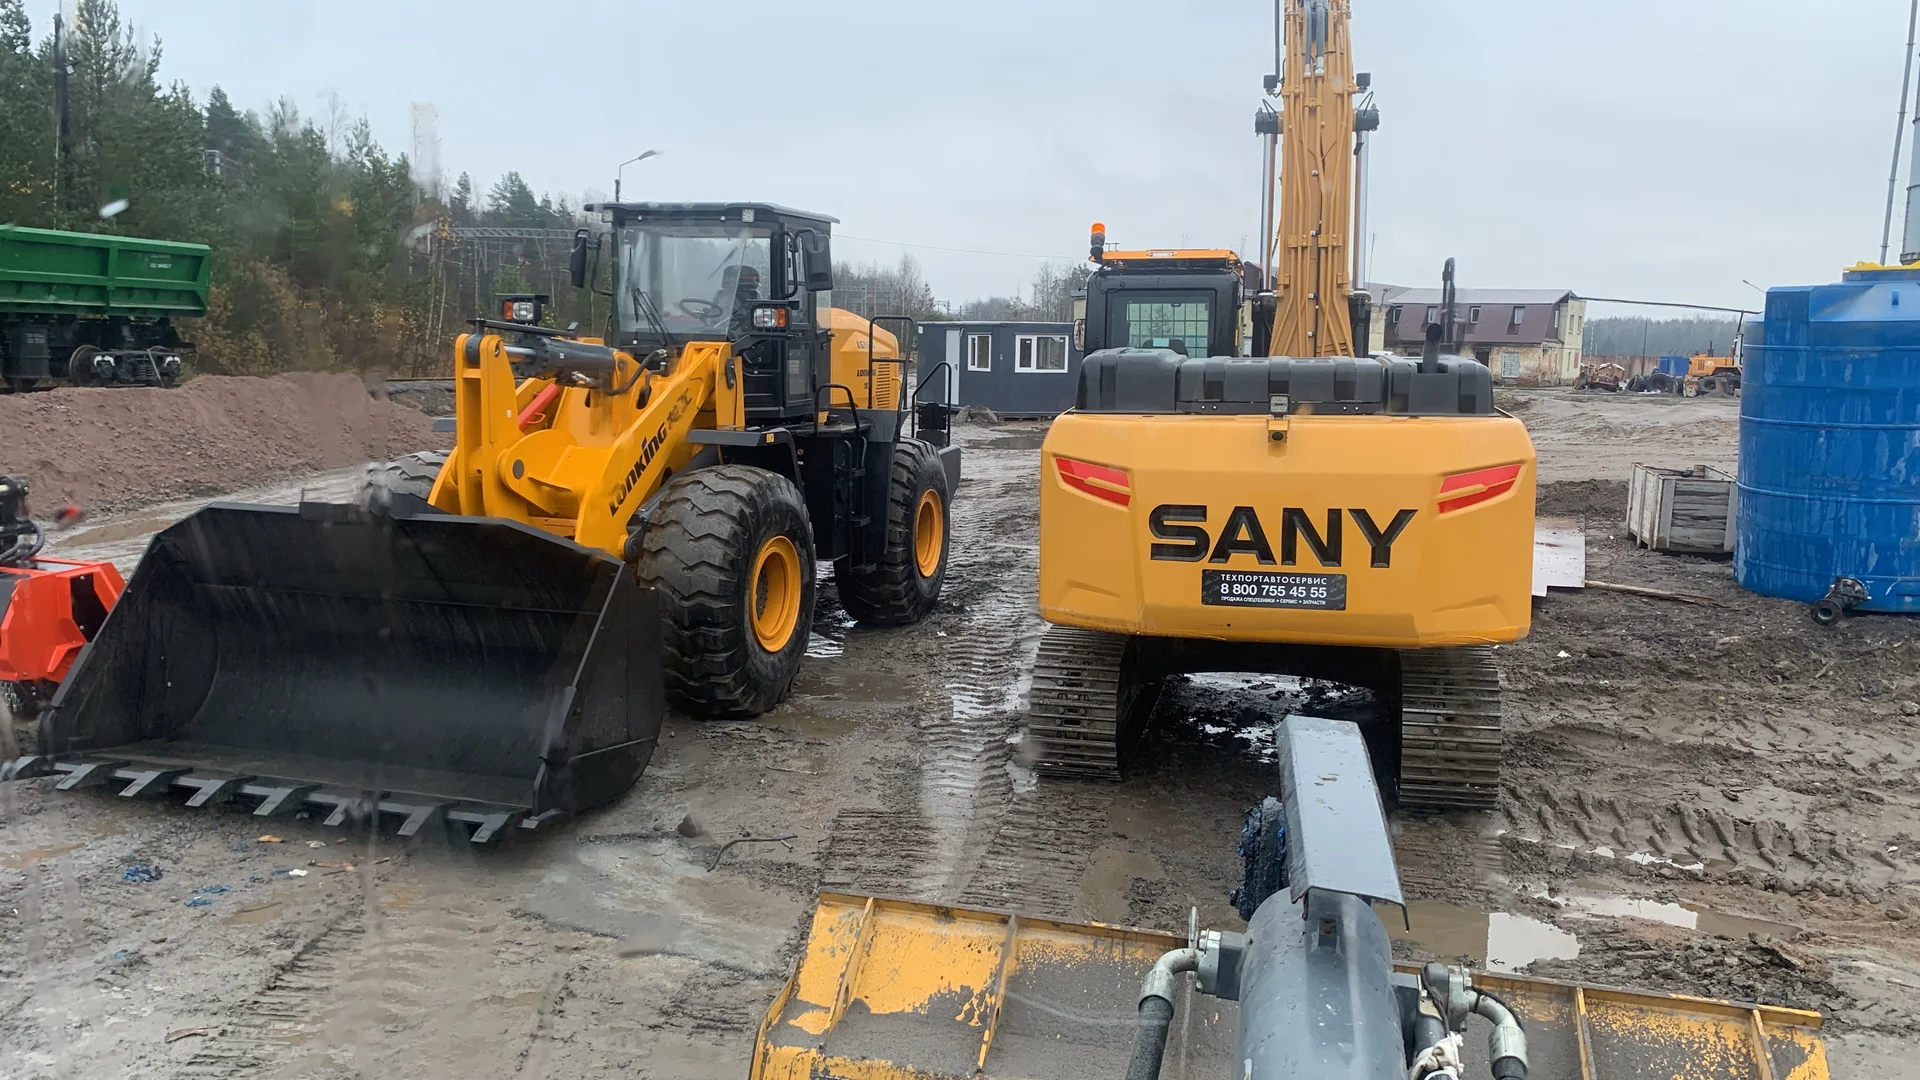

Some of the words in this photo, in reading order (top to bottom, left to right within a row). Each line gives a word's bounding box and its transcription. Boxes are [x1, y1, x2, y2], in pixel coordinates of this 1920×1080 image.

[1149, 504, 1419, 568] SANY
[1221, 573, 1327, 585] ТЕХПОРТАВТОСЕРВИС
[1220, 583, 1229, 594] 8
[1232, 584, 1257, 596] 800
[1261, 585, 1286, 597] 755
[1289, 586, 1307, 598] 45
[1309, 587, 1327, 598] 55
